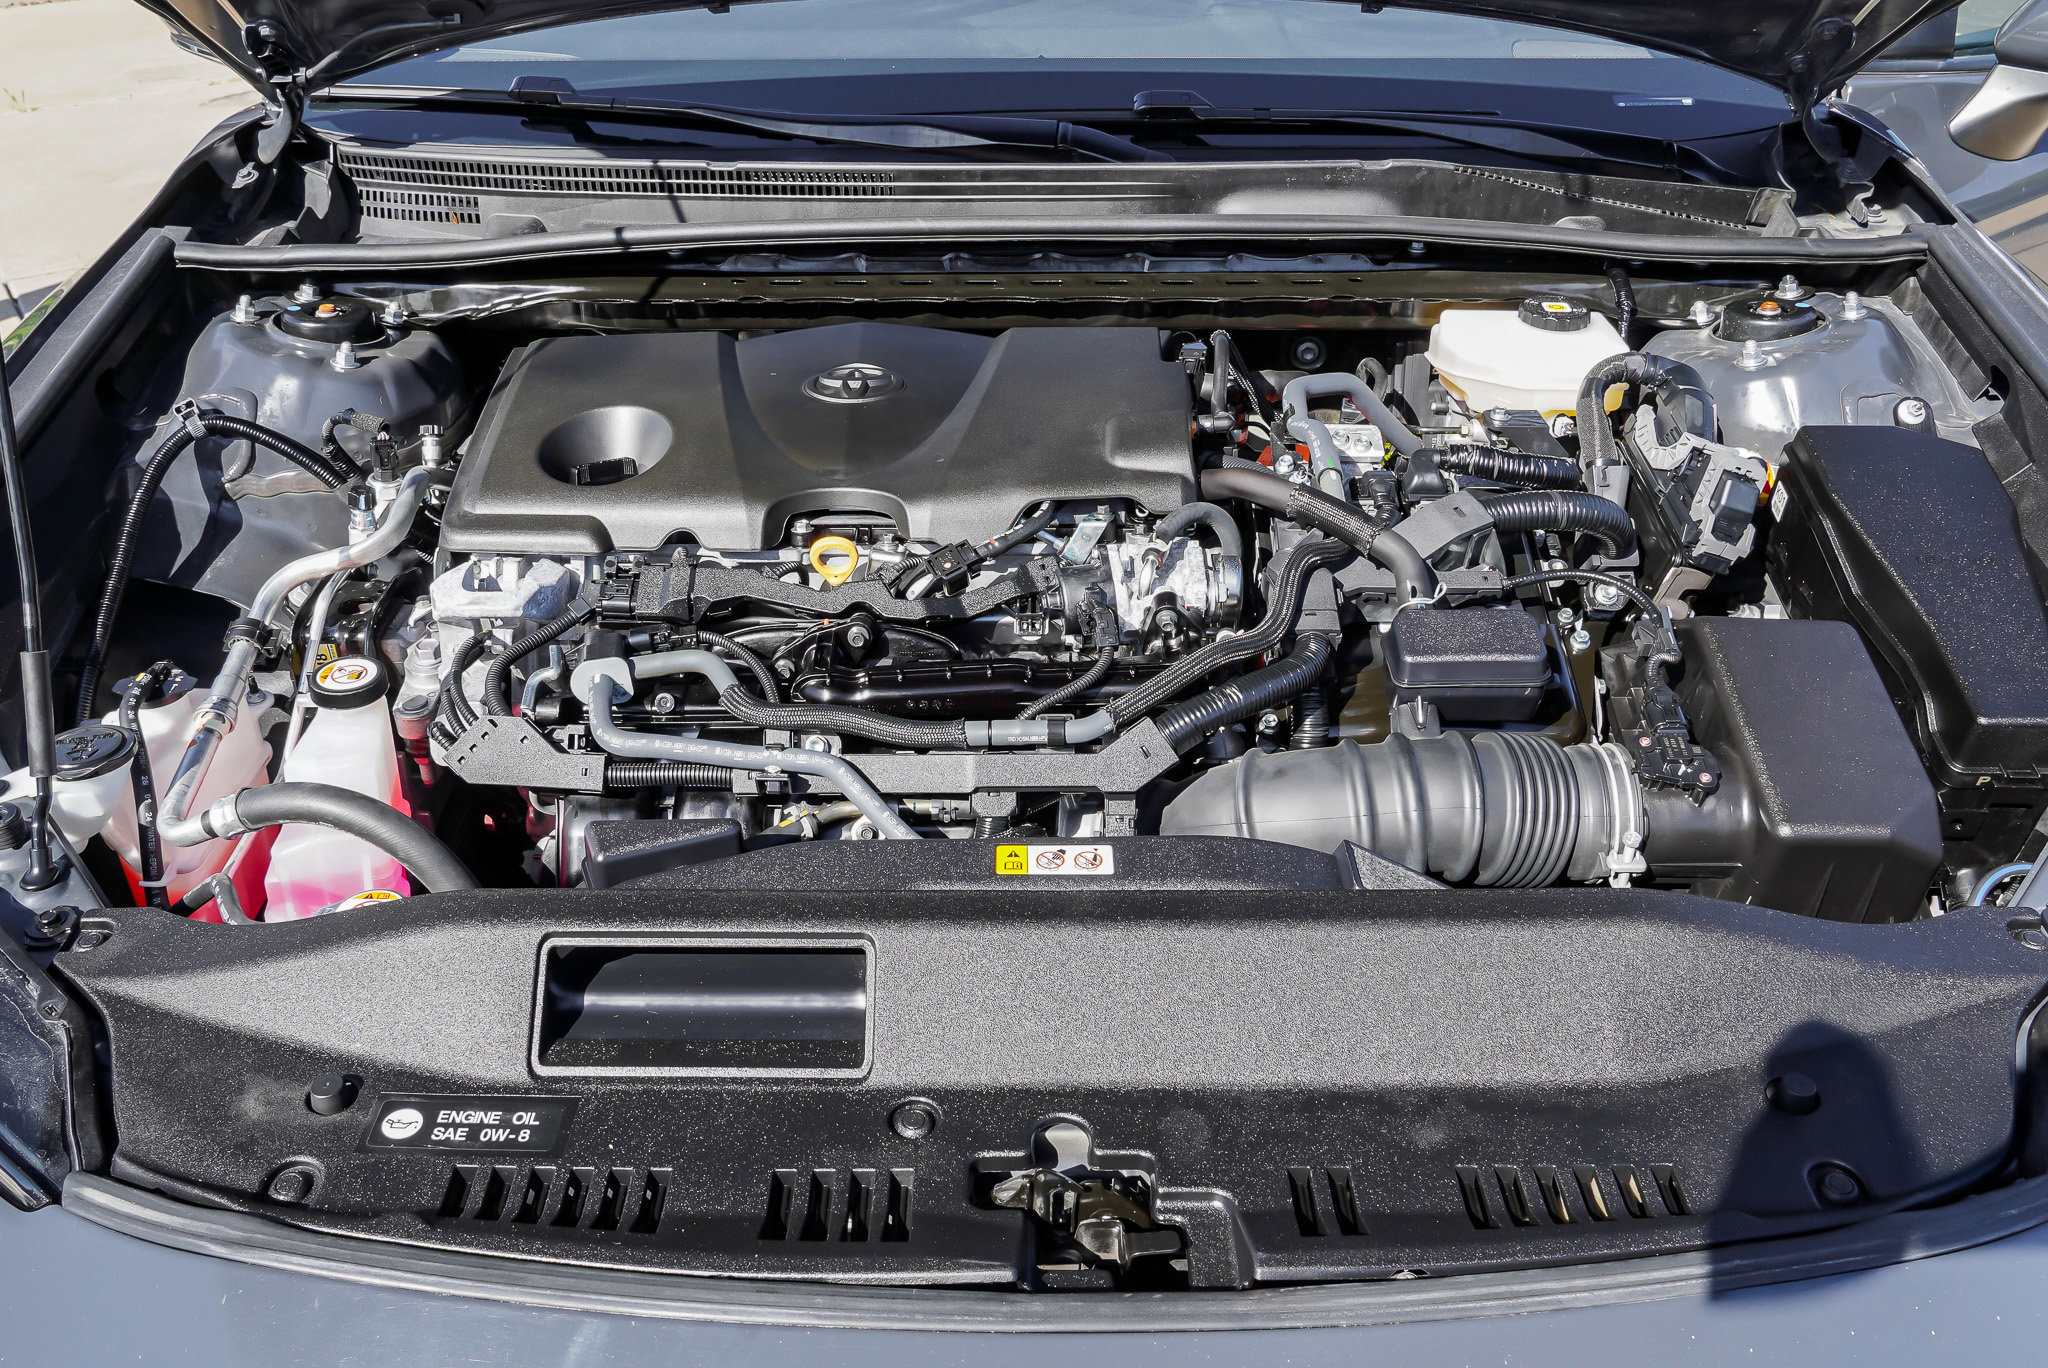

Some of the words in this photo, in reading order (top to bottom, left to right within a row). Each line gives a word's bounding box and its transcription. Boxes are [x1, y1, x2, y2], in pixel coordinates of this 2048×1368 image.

[1976, 776, 1991, 786] P
[437, 1110, 502, 1125] ENGINE
[512, 1112, 540, 1125] OIL
[430, 1127, 469, 1141] SAE
[479, 1129, 531, 1142] 0W-8
